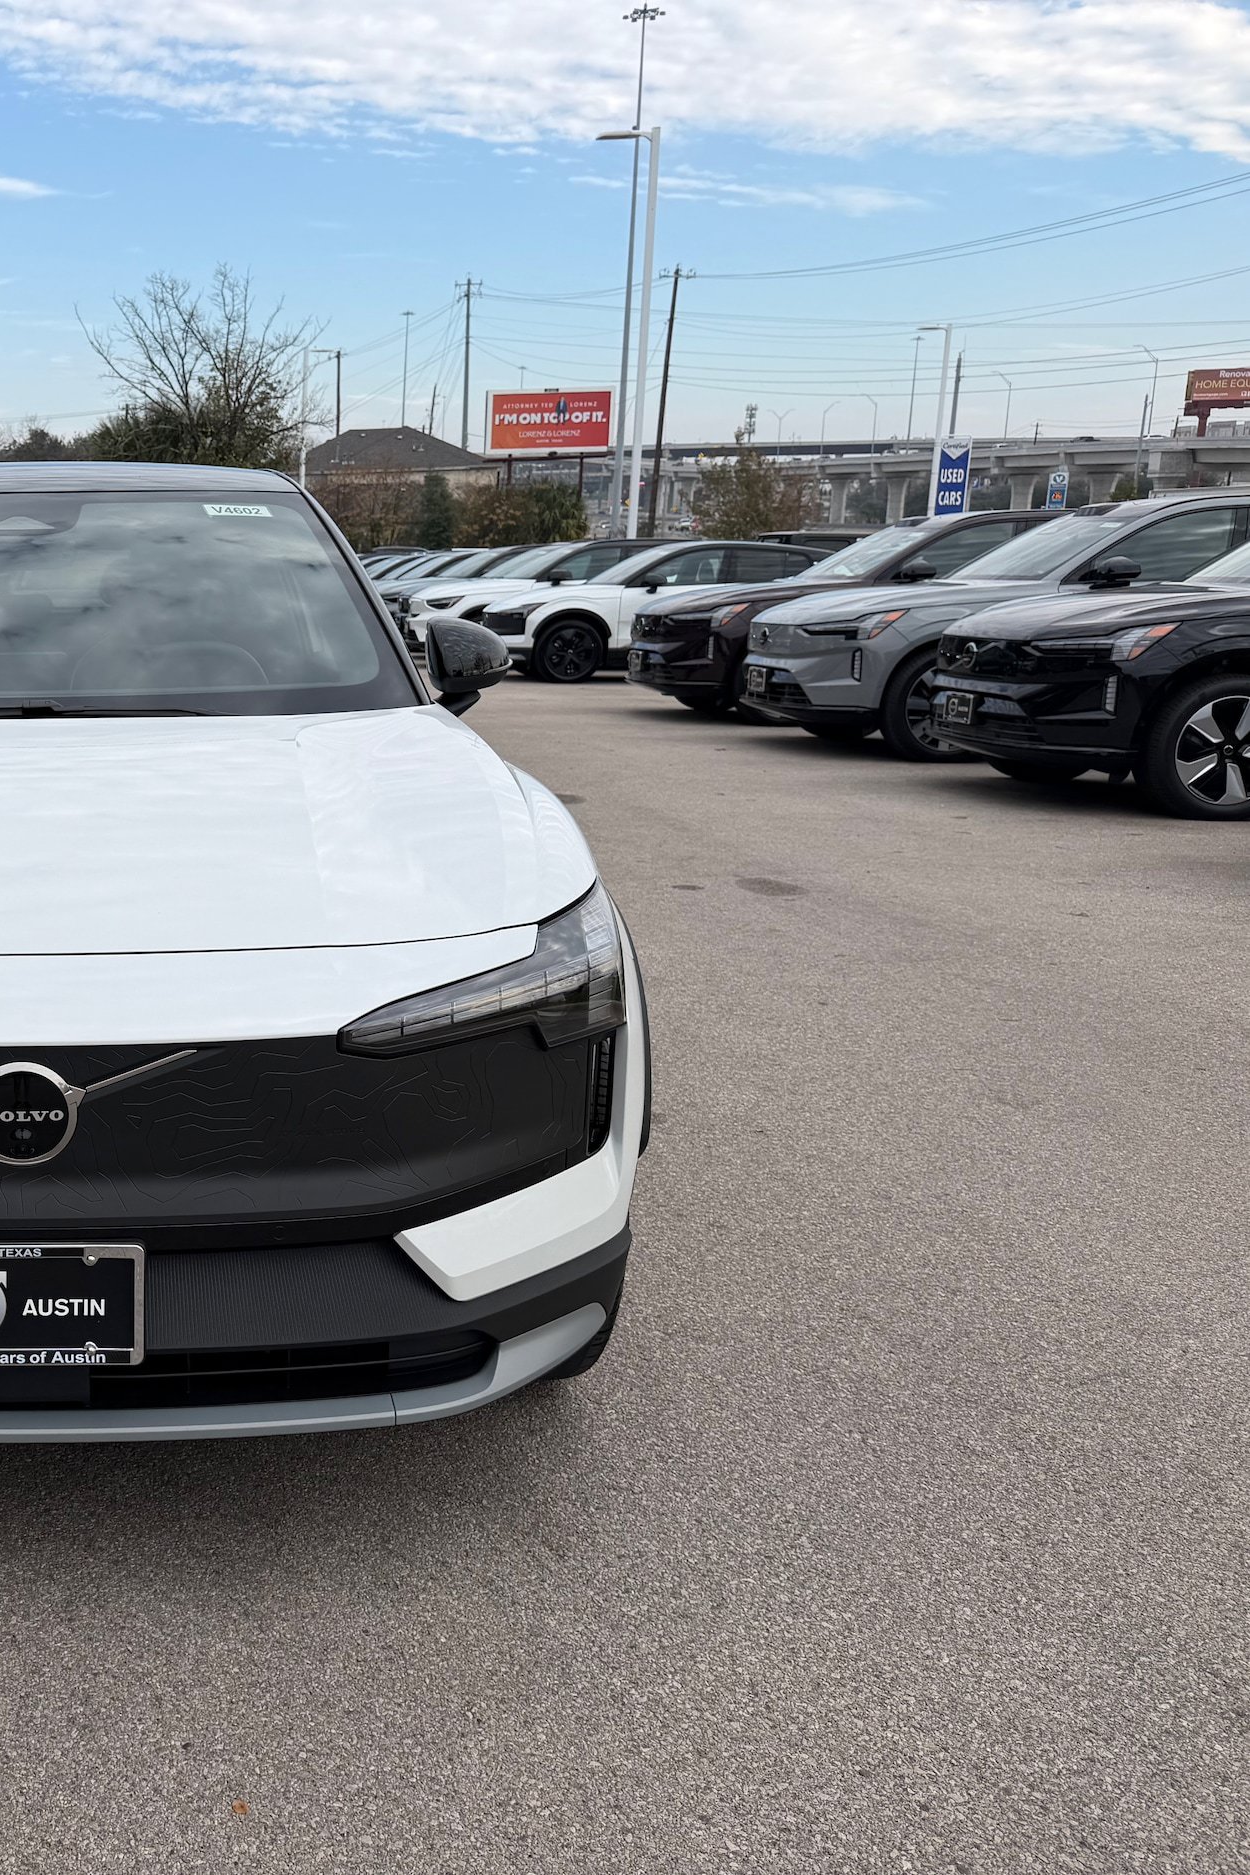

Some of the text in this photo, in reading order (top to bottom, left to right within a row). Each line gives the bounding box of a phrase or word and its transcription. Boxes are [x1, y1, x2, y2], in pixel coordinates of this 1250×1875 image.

[1195, 379, 1228, 389] HOME
[494, 413, 517, 425] I'M
[519, 412, 541, 424] ON
[571, 411, 591, 423] OF
[553, 429, 581, 437] LORENZ
[942, 442, 969, 450] Certified
[940, 468, 965, 483] USED
[938, 491, 962, 506] CARS
[211, 506, 262, 515] V4602
[22, 1299, 106, 1316] AUSTIN
[29, 1351, 48, 1364] of
[51, 1350, 106, 1364] Austin
